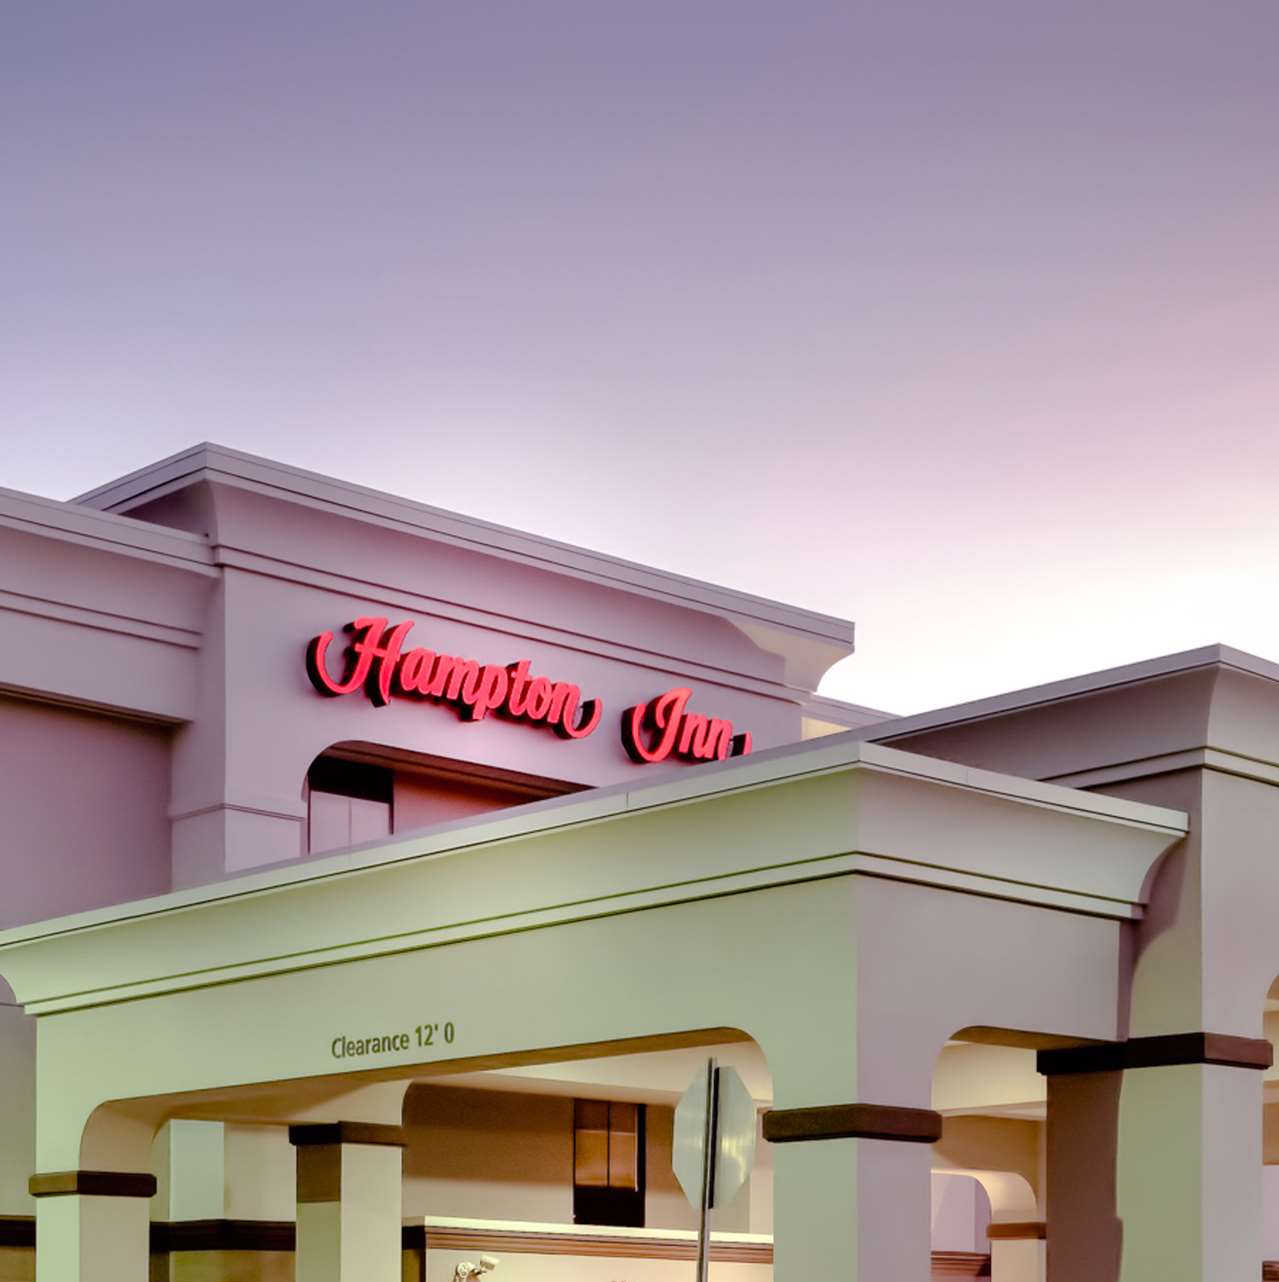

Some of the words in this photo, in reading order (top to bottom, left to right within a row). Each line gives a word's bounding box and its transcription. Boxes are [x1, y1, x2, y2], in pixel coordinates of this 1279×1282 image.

[306, 615, 602, 739] Hampton
[622, 687, 752, 763] Inn
[331, 1034, 410, 1059] Clearance
